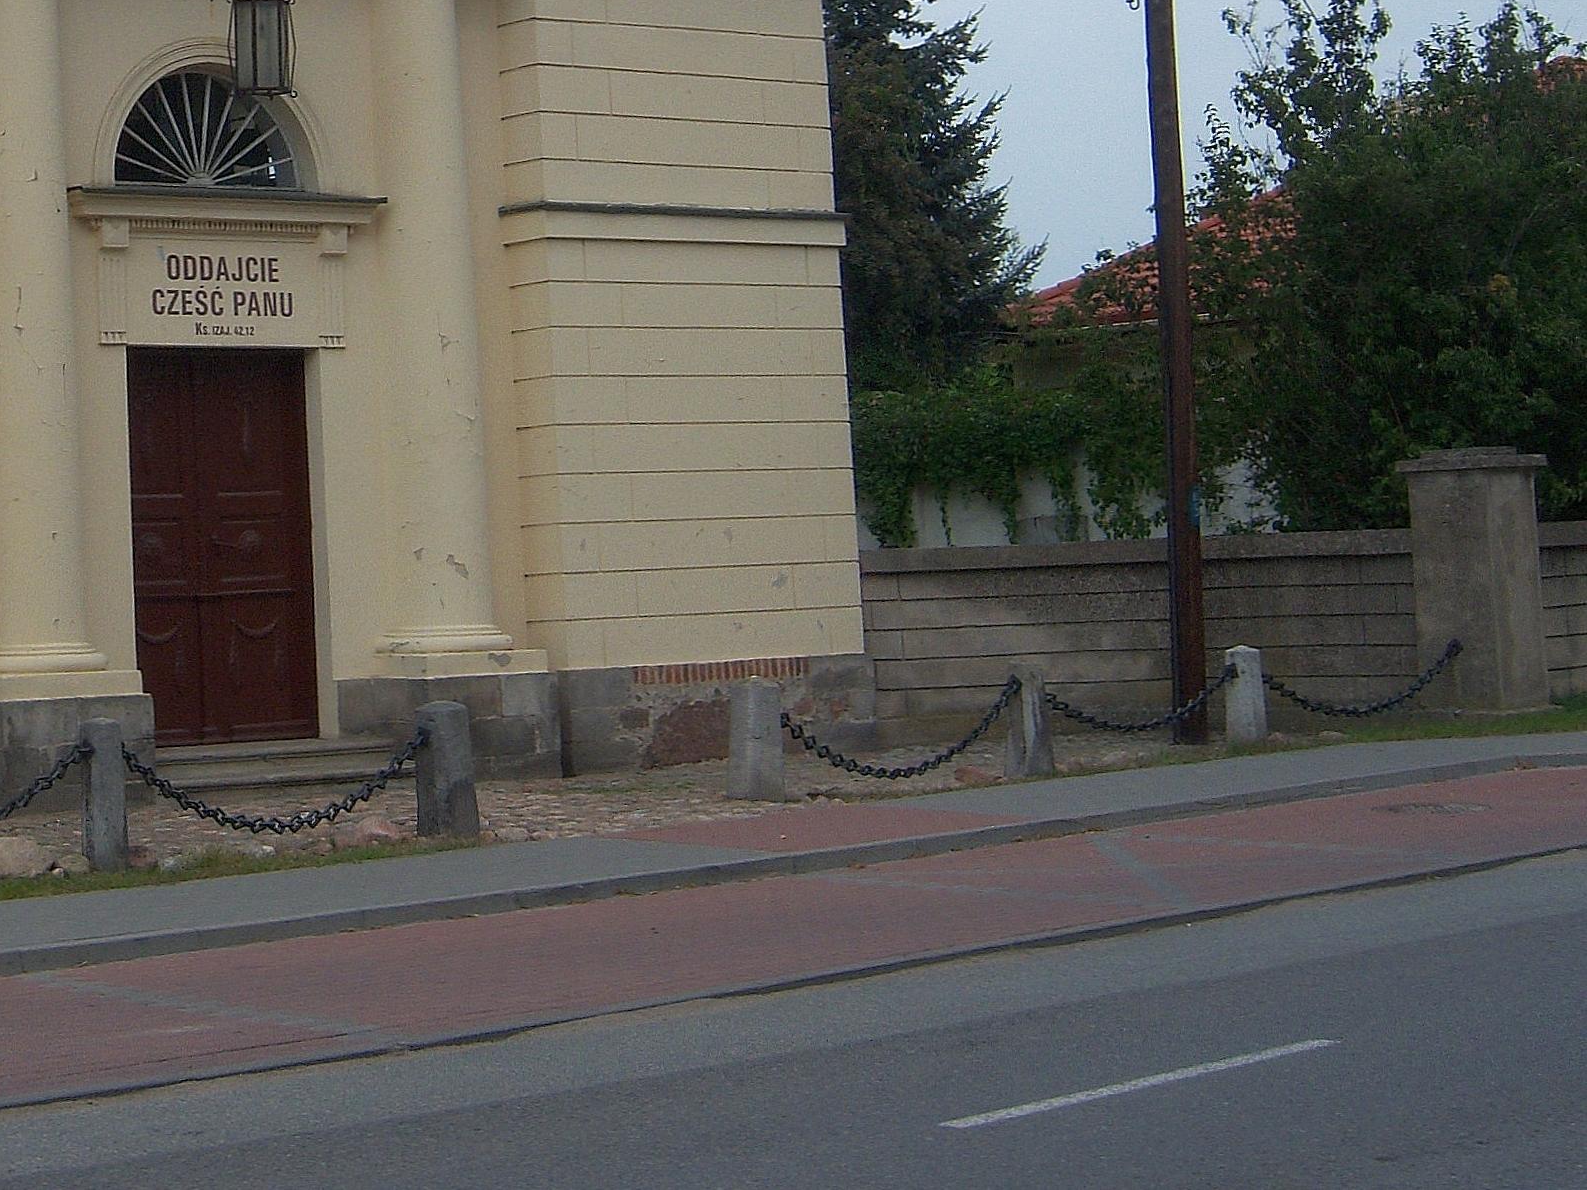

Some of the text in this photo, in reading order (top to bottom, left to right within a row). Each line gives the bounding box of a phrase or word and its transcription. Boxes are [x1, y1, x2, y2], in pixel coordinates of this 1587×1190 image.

[166, 254, 279, 283] ODDAJCIE
[152, 285, 293, 317] CZEŚĆ PANU
